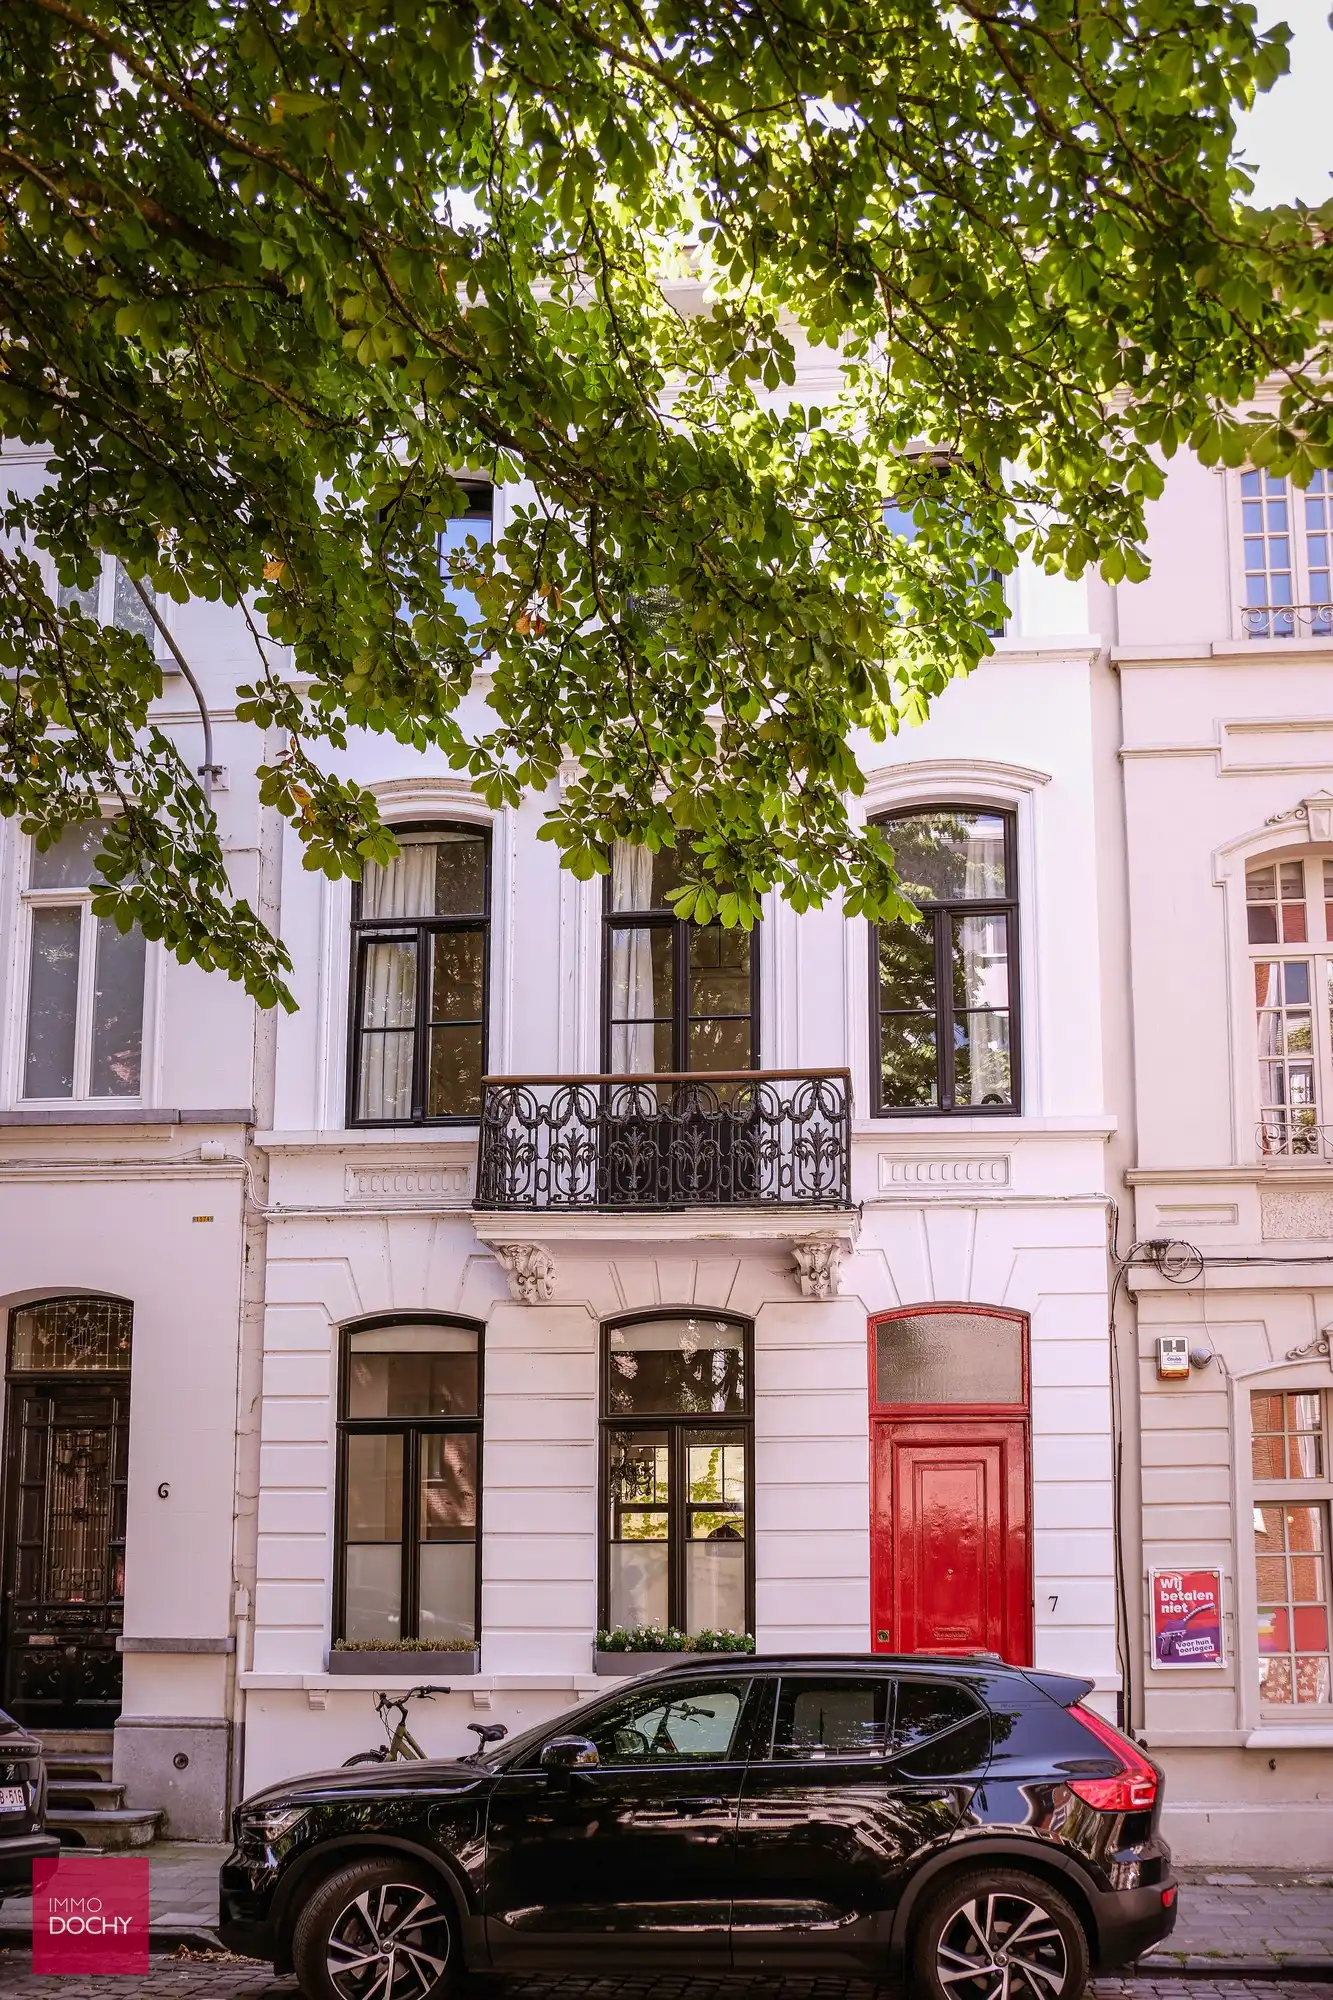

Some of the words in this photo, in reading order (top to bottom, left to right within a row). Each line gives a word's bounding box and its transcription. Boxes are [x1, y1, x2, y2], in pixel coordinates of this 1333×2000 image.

[158, 1482, 170, 1499] 6
[1160, 1577, 1182, 1591] Wij
[1161, 1591, 1214, 1601] betalen
[1048, 1596, 1058, 1612] 7
[1161, 1602, 1188, 1613] niet
[1179, 1644, 1213, 1653] oorlogen
